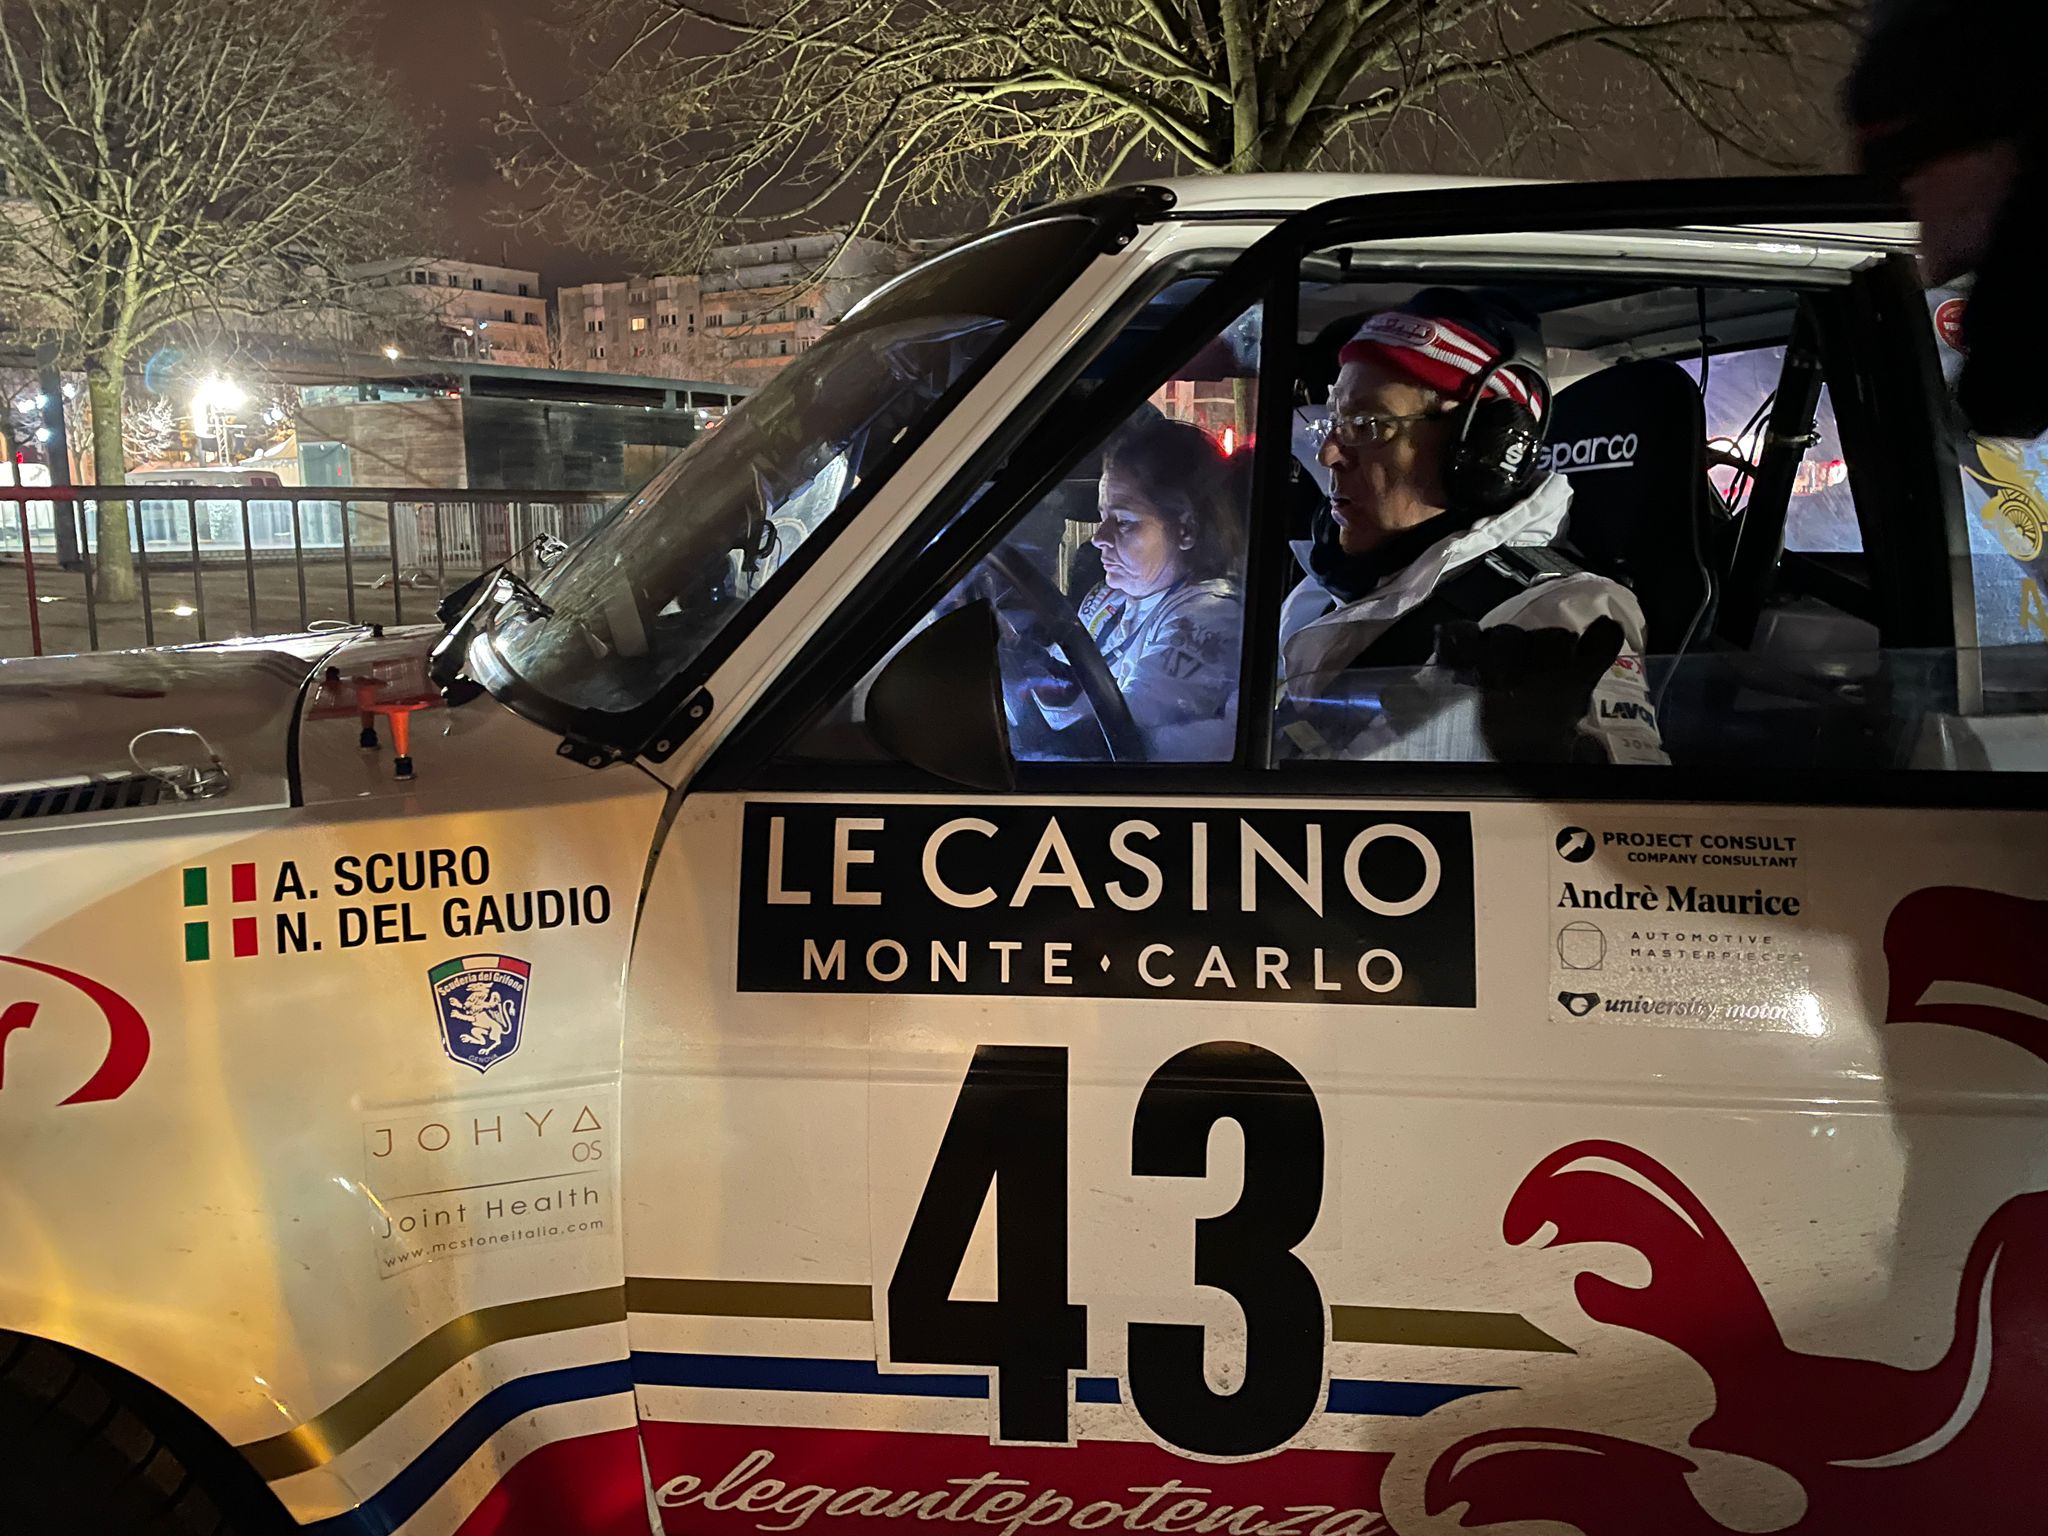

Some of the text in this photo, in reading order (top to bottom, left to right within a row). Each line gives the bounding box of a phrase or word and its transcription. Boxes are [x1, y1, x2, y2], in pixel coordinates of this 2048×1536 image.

[1602, 831, 1797, 851] PROJECT CONSULT
[272, 845, 491, 903] A. SCURO
[766, 814, 1442, 918] LE CASINO
[1627, 851, 1799, 869] COMPANY CONSULTANT
[1556, 881, 1801, 917] Andrè Maurice
[275, 884, 612, 955] N. DEL GAUDIO
[1630, 931, 1773, 946] AUTOMOTIVE
[437, 971, 524, 996] Scuderia del Grifone
[801, 937, 1404, 994] MONTE CARLO
[571, 1140, 603, 1163] OS
[486, 1186, 600, 1219] Health
[383, 1218, 605, 1269] www.mcstoneitalia.com
[887, 1039, 1325, 1457] 43
